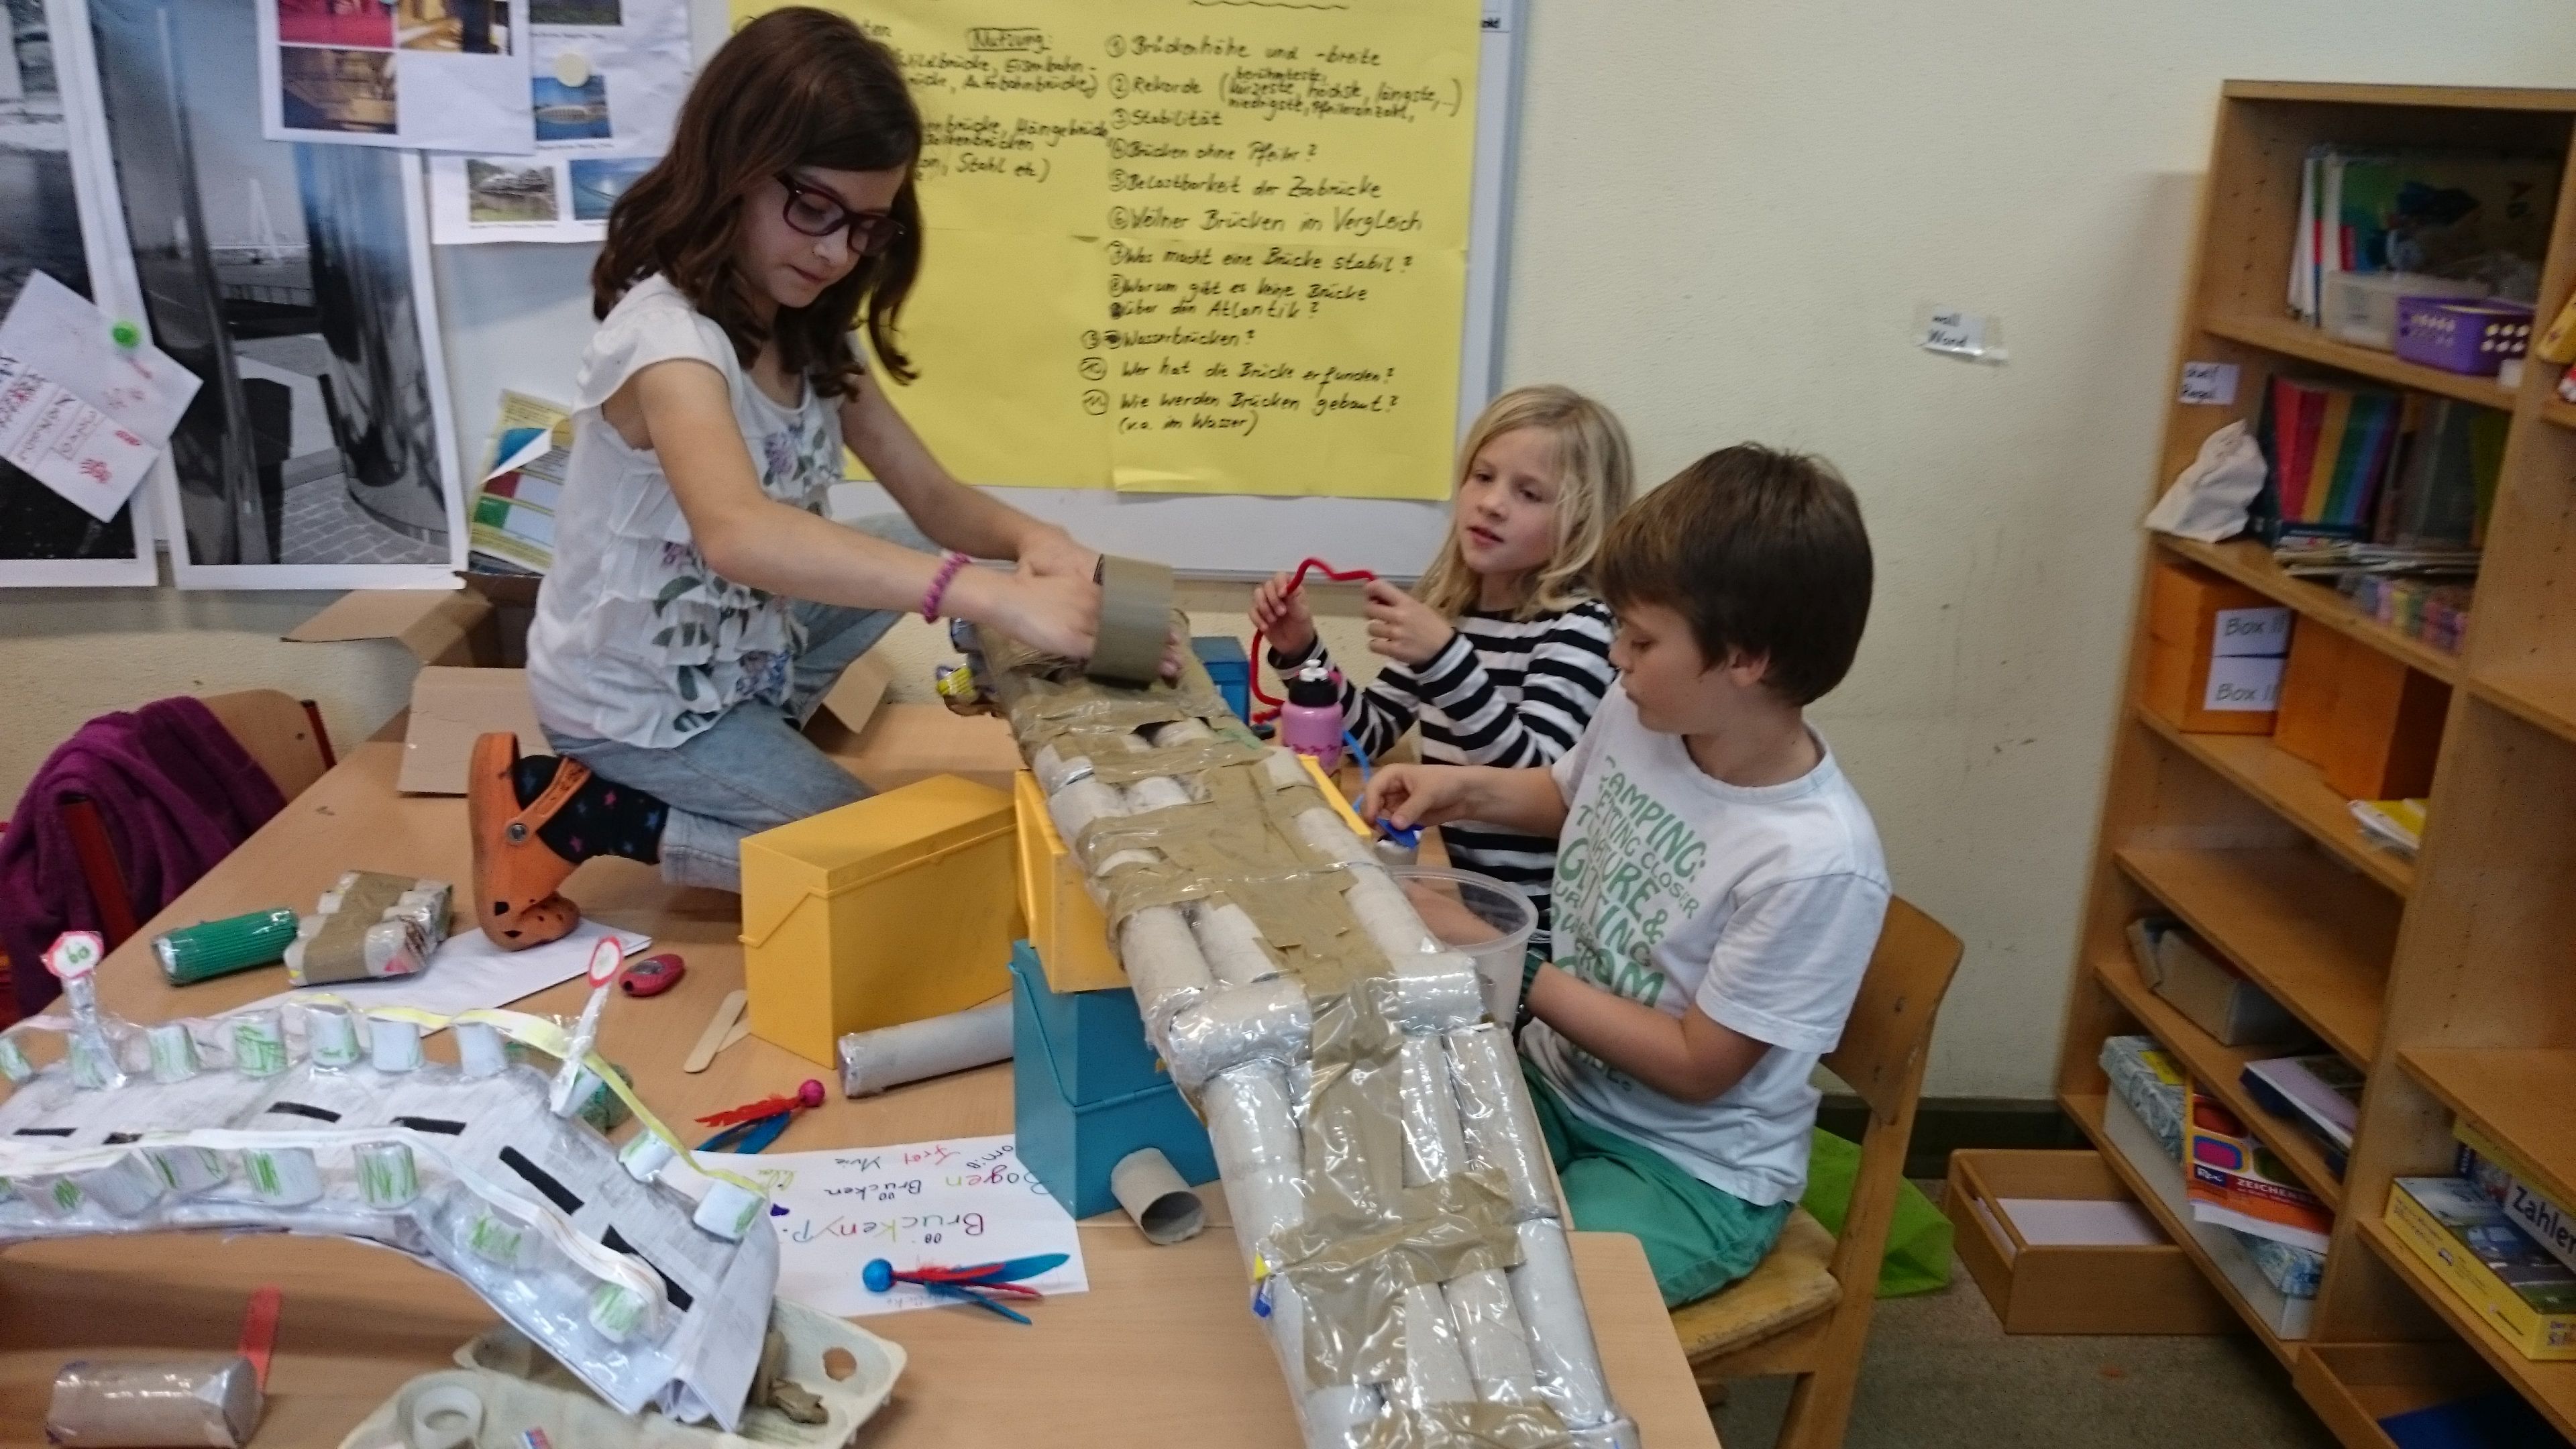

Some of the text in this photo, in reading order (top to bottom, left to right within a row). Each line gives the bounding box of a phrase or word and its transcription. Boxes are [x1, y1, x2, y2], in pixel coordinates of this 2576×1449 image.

[1266, 46, 1299, 60] und
[1132, 76, 1201, 94] Rekorde
[1131, 109, 1222, 127] Stabilität
[1195, 143, 1235, 160] ohne
[1252, 179, 1280, 196] der
[1200, 209, 1285, 231] Brücken
[1299, 212, 1323, 231] im
[1334, 206, 1422, 236] Vergleich
[1163, 248, 1213, 265] macht
[1222, 252, 1253, 266] eine
[1263, 246, 1322, 269] Brücke
[1124, 278, 1178, 294] Warum
[1188, 280, 1220, 303] gibt
[1230, 284, 1247, 295] es
[1256, 277, 1295, 297] keine
[1306, 282, 1368, 301] Brücke
[1123, 301, 1157, 316] über
[1171, 299, 1197, 316] den
[1122, 362, 1149, 376] Wer
[1159, 356, 1191, 376] hat
[1206, 362, 1228, 378] die
[1238, 362, 1295, 380] Brücke
[1120, 393, 1149, 410] Wie
[1160, 392, 1218, 407] werden
[1230, 392, 1300, 411] Brücken
[1164, 415, 1182, 429] im
[1191, 409, 1258, 437] Wasser)
[2225, 617, 2265, 636] Box
[2216, 683, 2257, 701] Box
[1641, 852, 1699, 919] CLOSER
[1643, 908, 1668, 945] &
